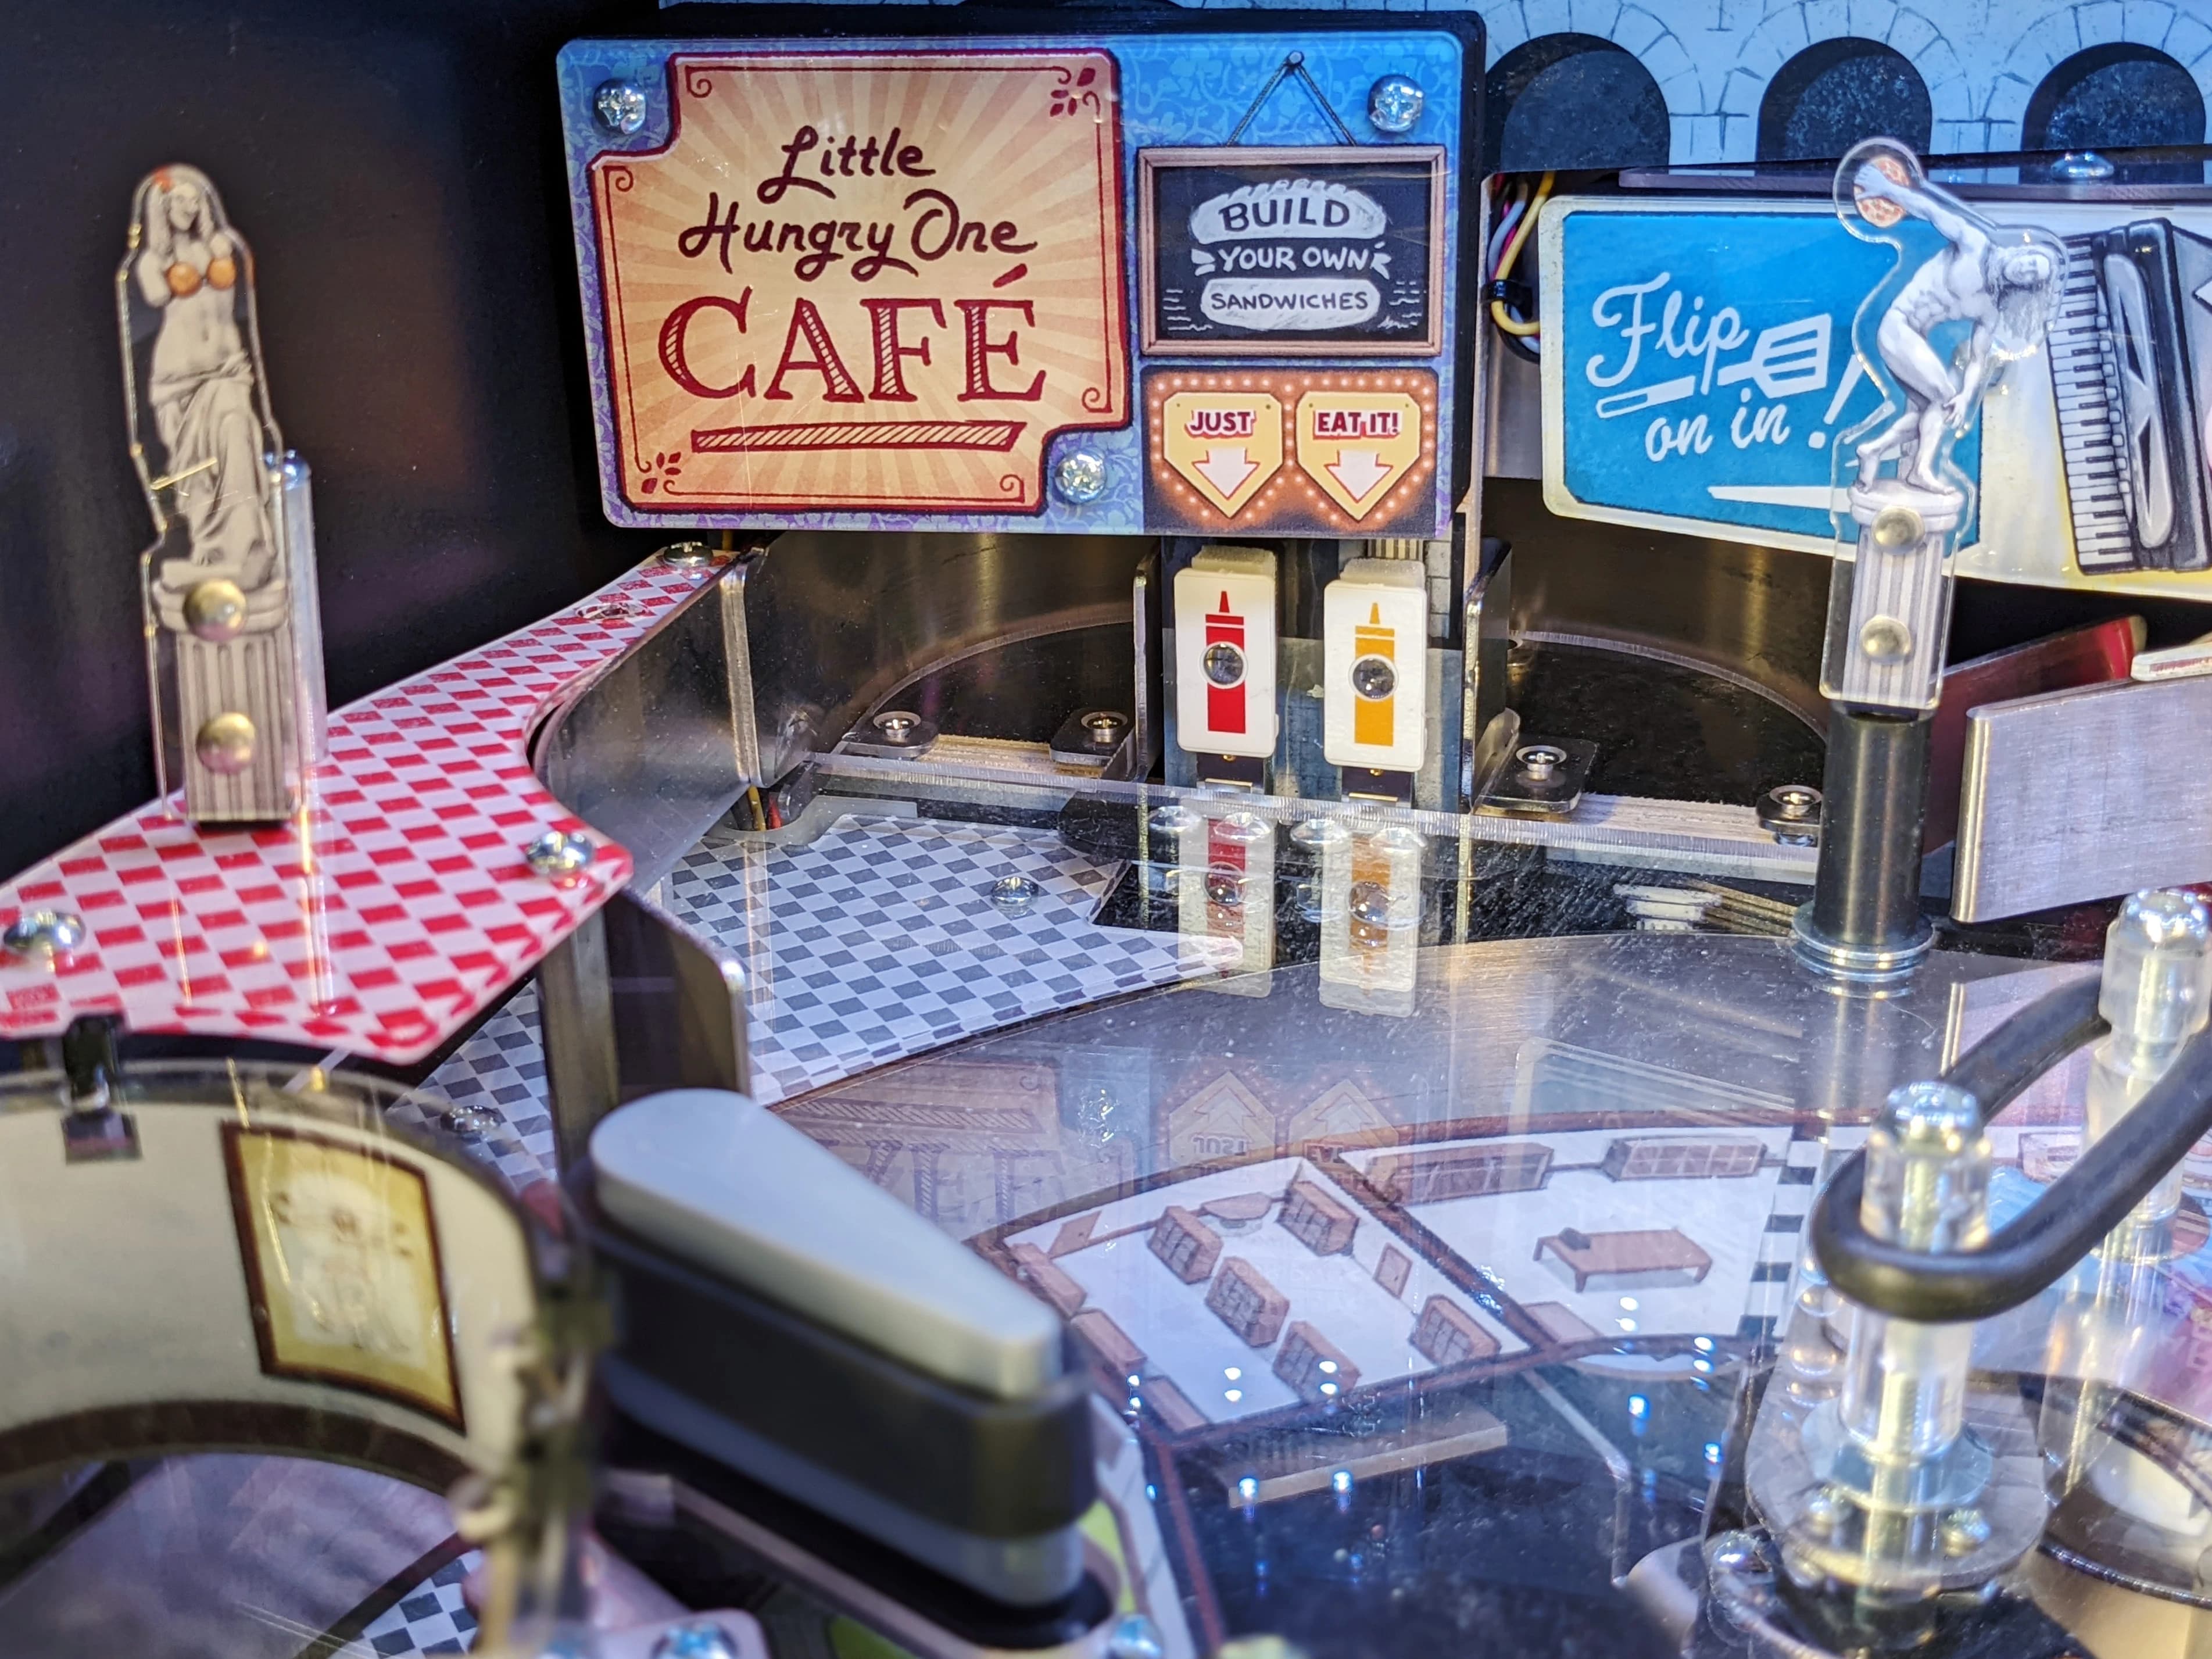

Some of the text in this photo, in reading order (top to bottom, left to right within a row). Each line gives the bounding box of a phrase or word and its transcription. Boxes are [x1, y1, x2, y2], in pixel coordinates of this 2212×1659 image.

[757, 125, 936, 204] Little
[678, 188, 1039, 282] Hungry One
[1218, 196, 1351, 232] BUILD
[1218, 246, 1370, 272] YOUR OWN
[1211, 291, 1369, 311] SANDWICHES
[657, 263, 1046, 403] CAFÉ
[1585, 271, 1749, 395] Flip
[1188, 409, 1254, 434] JUST
[1316, 411, 1399, 435] EAT IT!
[1644, 413, 1713, 463] on
